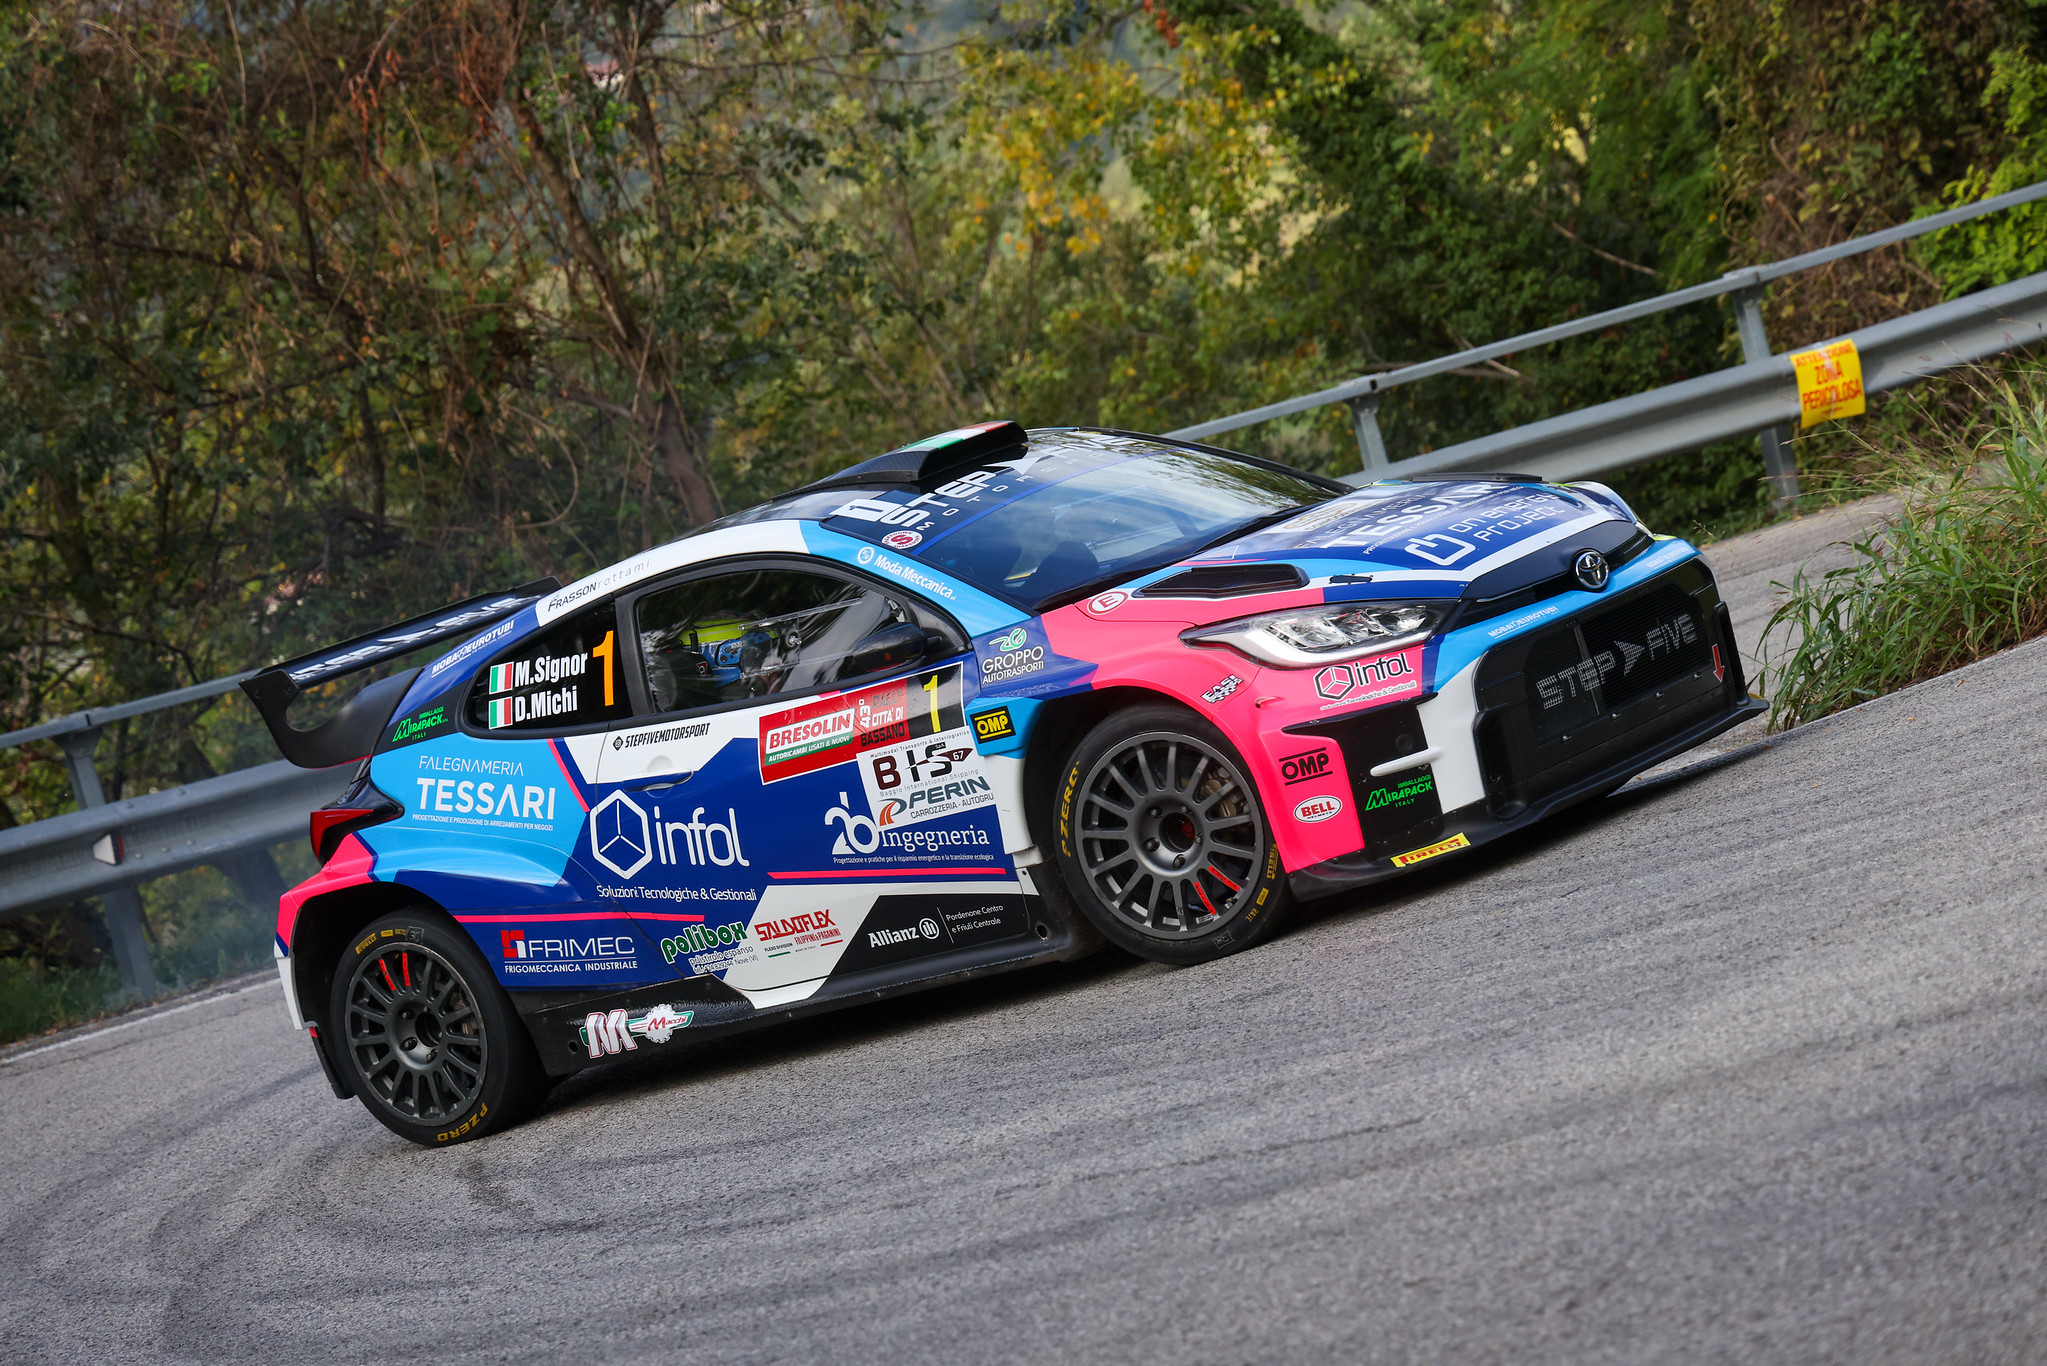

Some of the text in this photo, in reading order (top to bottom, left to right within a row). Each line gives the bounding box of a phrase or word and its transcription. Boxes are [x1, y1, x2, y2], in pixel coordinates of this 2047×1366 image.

[1802, 379, 1863, 411] PERICOLOSA
[874, 554, 902, 576] Moda
[901, 566, 953, 600] Meccanica
[1098, 595, 1118, 609] E
[432, 651, 458, 674] MOBA
[465, 619, 515, 654] EUROTUBI
[981, 645, 1044, 674] GROPPO
[514, 629, 615, 707] M.Signor 1
[982, 660, 1044, 685] AUTOTRASPORTI
[1354, 652, 1413, 686] infol
[1535, 612, 1698, 710] STEP FIVE
[514, 684, 578, 722] D.Michi
[871, 687, 903, 709] RALLY
[923, 674, 941, 734] 1
[895, 706, 904, 720] DI
[976, 714, 1009, 736] OMP
[624, 722, 711, 749] STEPFIVEMOTORSPORT
[769, 711, 850, 750] BRESOLIN
[860, 721, 906, 747] BASSANO
[768, 746, 808, 763] AUTORICAMBI
[808, 742, 826, 755] USATI
[832, 735, 850, 747] NUOVI
[418, 755, 524, 777] FALEGNAMERIA
[873, 741, 953, 791] BIS
[952, 750, 964, 761] 67
[904, 776, 948, 791] International
[949, 768, 979, 781] Shipping
[1281, 752, 1329, 780] OMP
[416, 777, 556, 820] TESSARI
[908, 775, 991, 810] PERIN
[910, 802, 958, 819] CARROZZERIA
[961, 792, 995, 808] AUTOGRU
[1364, 780, 1433, 811] MIRAPACK
[1395, 797, 1415, 808] ITALY
[411, 813, 450, 823] PROGETTAZIONE
[453, 816, 484, 827] PRODUZIONE
[483, 818, 490, 827] DI
[489, 819, 524, 829] ARREDAMENTI
[523, 822, 534, 830] PER
[534, 823, 554, 832] NEGOZI
[1060, 766, 1079, 858] P ZERO
[1300, 800, 1335, 818] BELL
[653, 804, 751, 868] infol
[881, 824, 990, 853] Ingegneria
[832, 856, 864, 865] Progettazione
[867, 855, 886, 864] pratiche
[897, 854, 917, 863] risparmio
[917, 854, 941, 863] energetico
[973, 853, 994, 862] ecologica
[1398, 838, 1462, 864] PIRELLI
[596, 884, 757, 903] Soluzioni Tecnologiche & Gestionali
[945, 905, 1004, 921] Pordenone Centro
[956, 921, 973, 932] Friuli
[973, 917, 1002, 929] Centrale
[528, 936, 635, 959] FRIMEC
[660, 921, 748, 964] polibox
[867, 927, 920, 949] Allianz
[724, 946, 754, 959] espanso
[734, 957, 749, 965] Nove
[504, 960, 638, 974] FRIGOMECCANICA INDUSTRIALE
[436, 1102, 489, 1142] P ZERO
